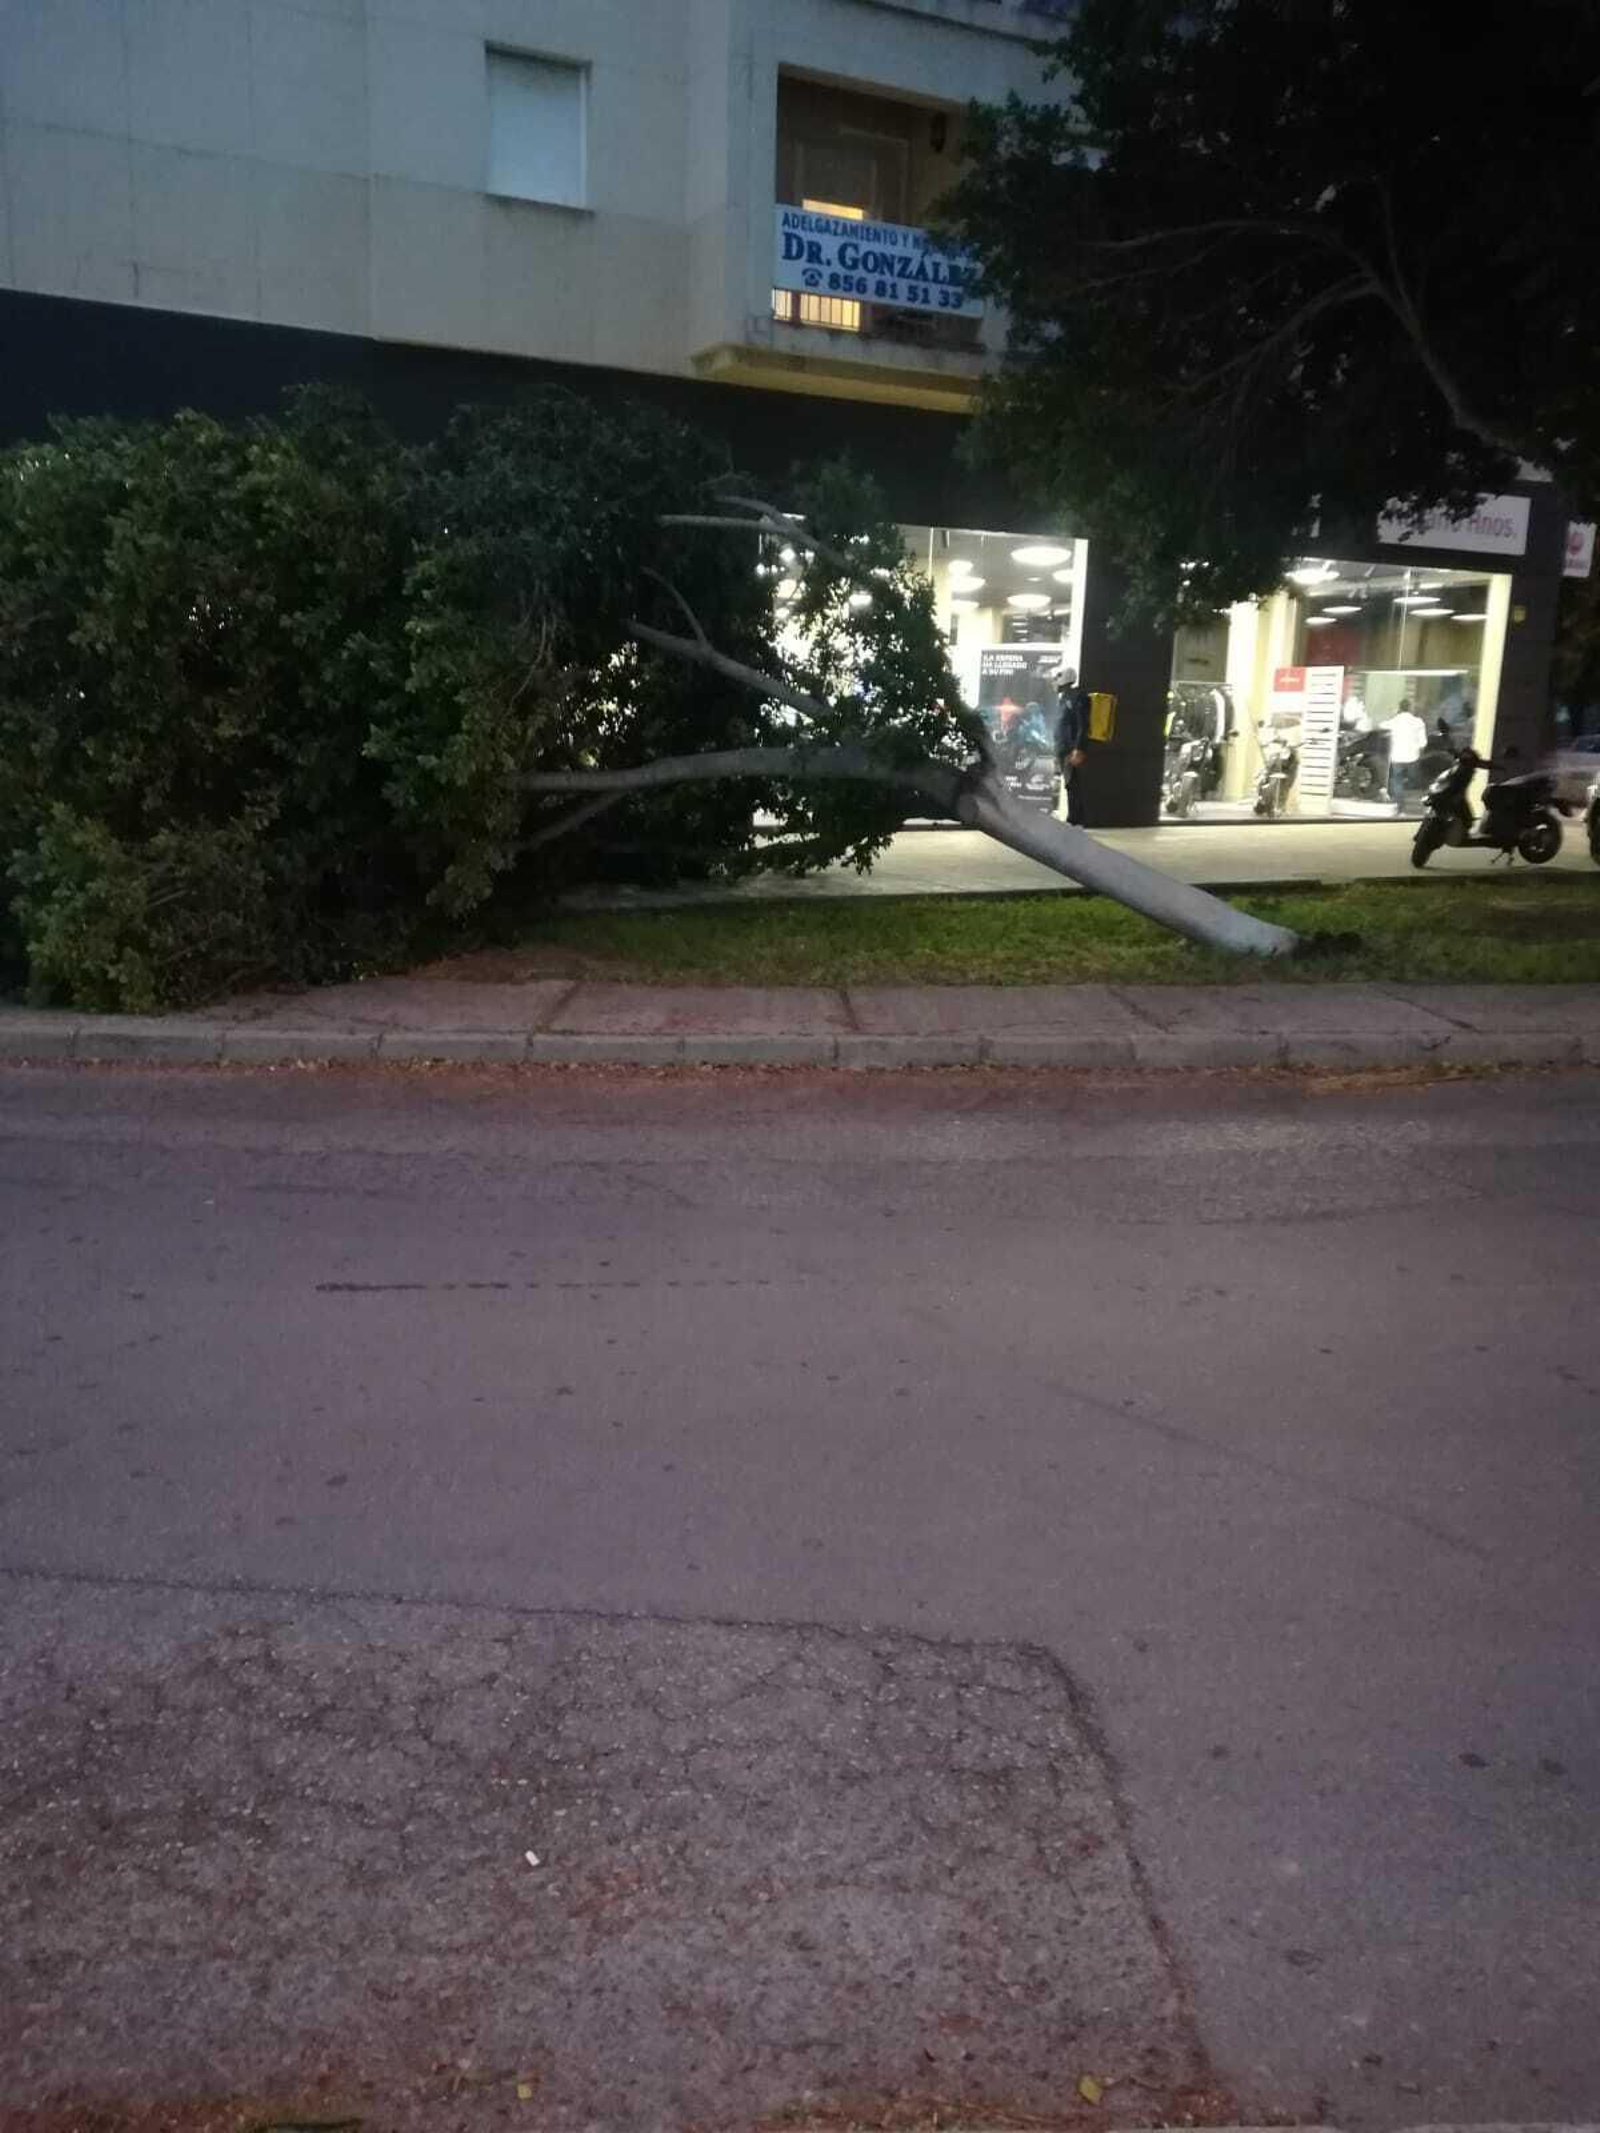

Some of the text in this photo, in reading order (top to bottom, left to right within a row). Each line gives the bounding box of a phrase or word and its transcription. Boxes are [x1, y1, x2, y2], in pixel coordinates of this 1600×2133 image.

[782, 212, 898, 246] ADELGAZAMIENTO
[901, 232, 910, 247] Y
[828, 272, 868, 296] 856
[874, 280, 899, 300] 81
[906, 286, 931, 305] 51
